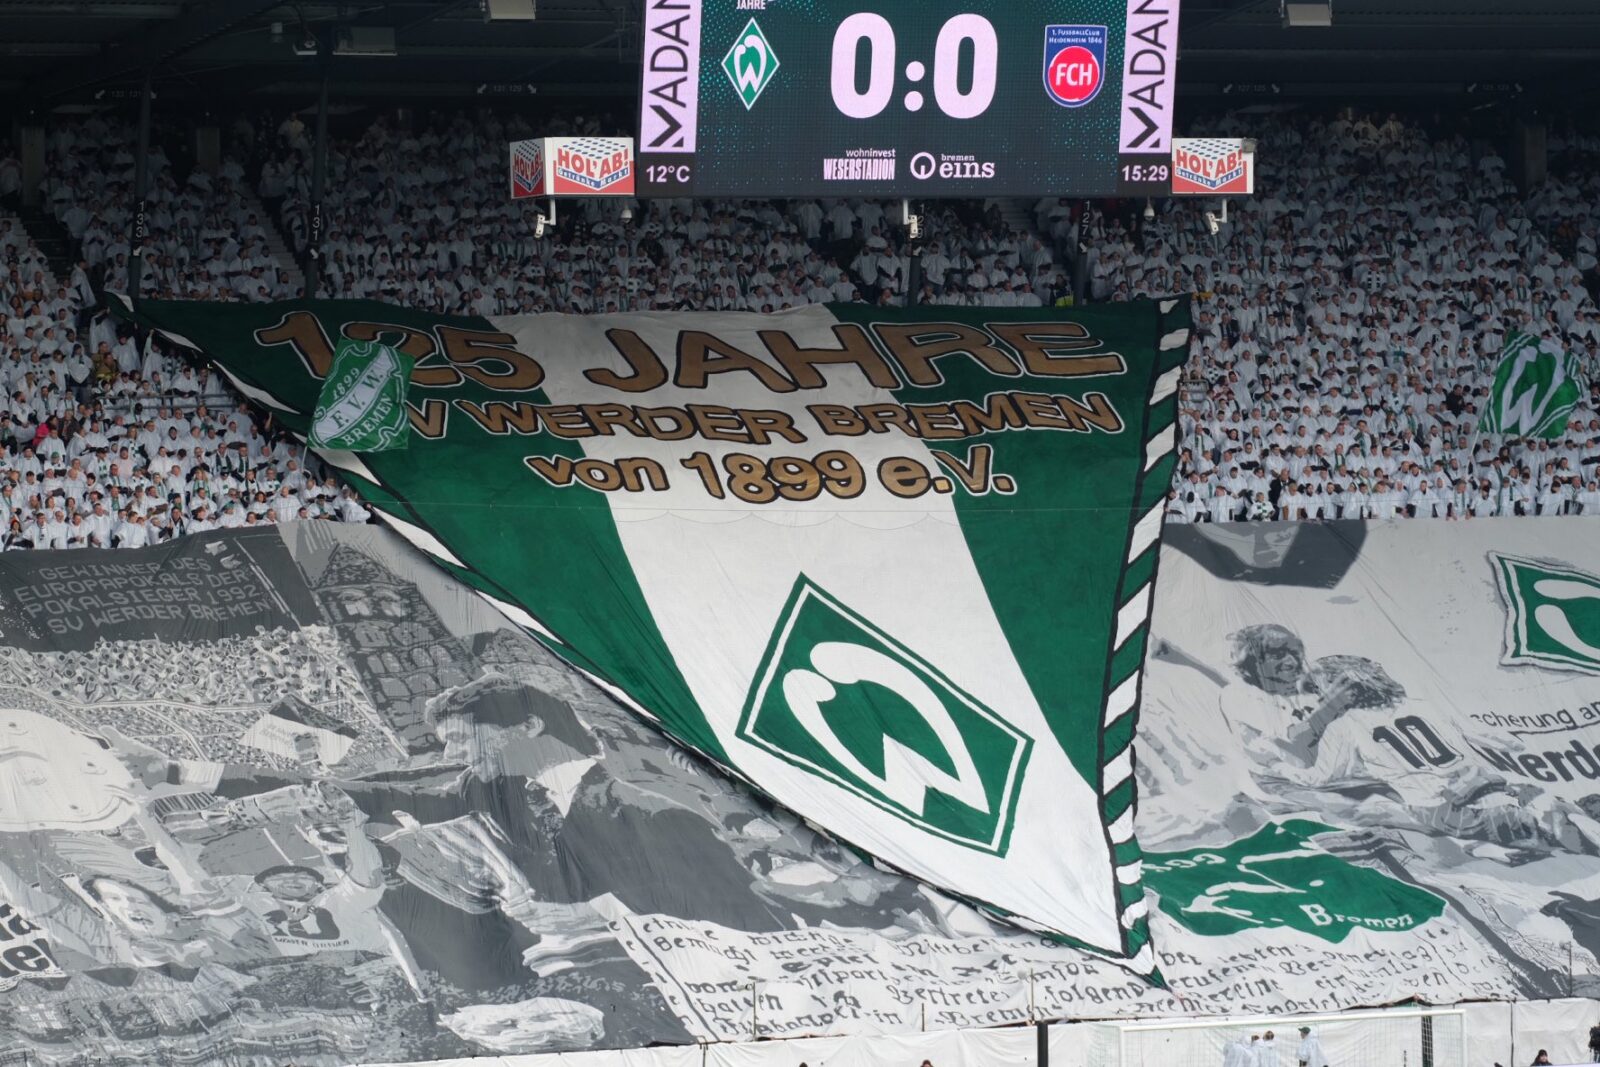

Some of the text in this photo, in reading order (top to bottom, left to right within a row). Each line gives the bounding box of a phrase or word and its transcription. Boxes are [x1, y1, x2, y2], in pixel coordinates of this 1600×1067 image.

[1055, 62, 1093, 87] FCH
[823, 158, 896, 180] WESERSTADION
[845, 148, 896, 157] wohninvest
[646, 165, 690, 183] 12°C
[939, 162, 995, 179] eins
[1122, 165, 1168, 182] 15:29
[134, 201, 145, 238] 133
[311, 204, 321, 241] 131
[1081, 200, 1092, 235] 127
[254, 310, 1127, 393] 125 JAHRE
[331, 369, 384, 429] F. V. W.
[332, 368, 360, 400] 1899
[342, 393, 393, 446] BREMEN
[454, 399, 808, 444] WERDER
[806, 391, 1125, 439] BREMEN
[523, 444, 1017, 503] von 1899 e.V.
[13, 568, 251, 601] EUROPAPOKALS DER
[38, 557, 212, 581] GEWINNER DES
[23, 584, 262, 619] POKALSIEGER 1992
[47, 599, 272, 634] SV WERDER BREMEN
[1373, 715, 1463, 770] 10
